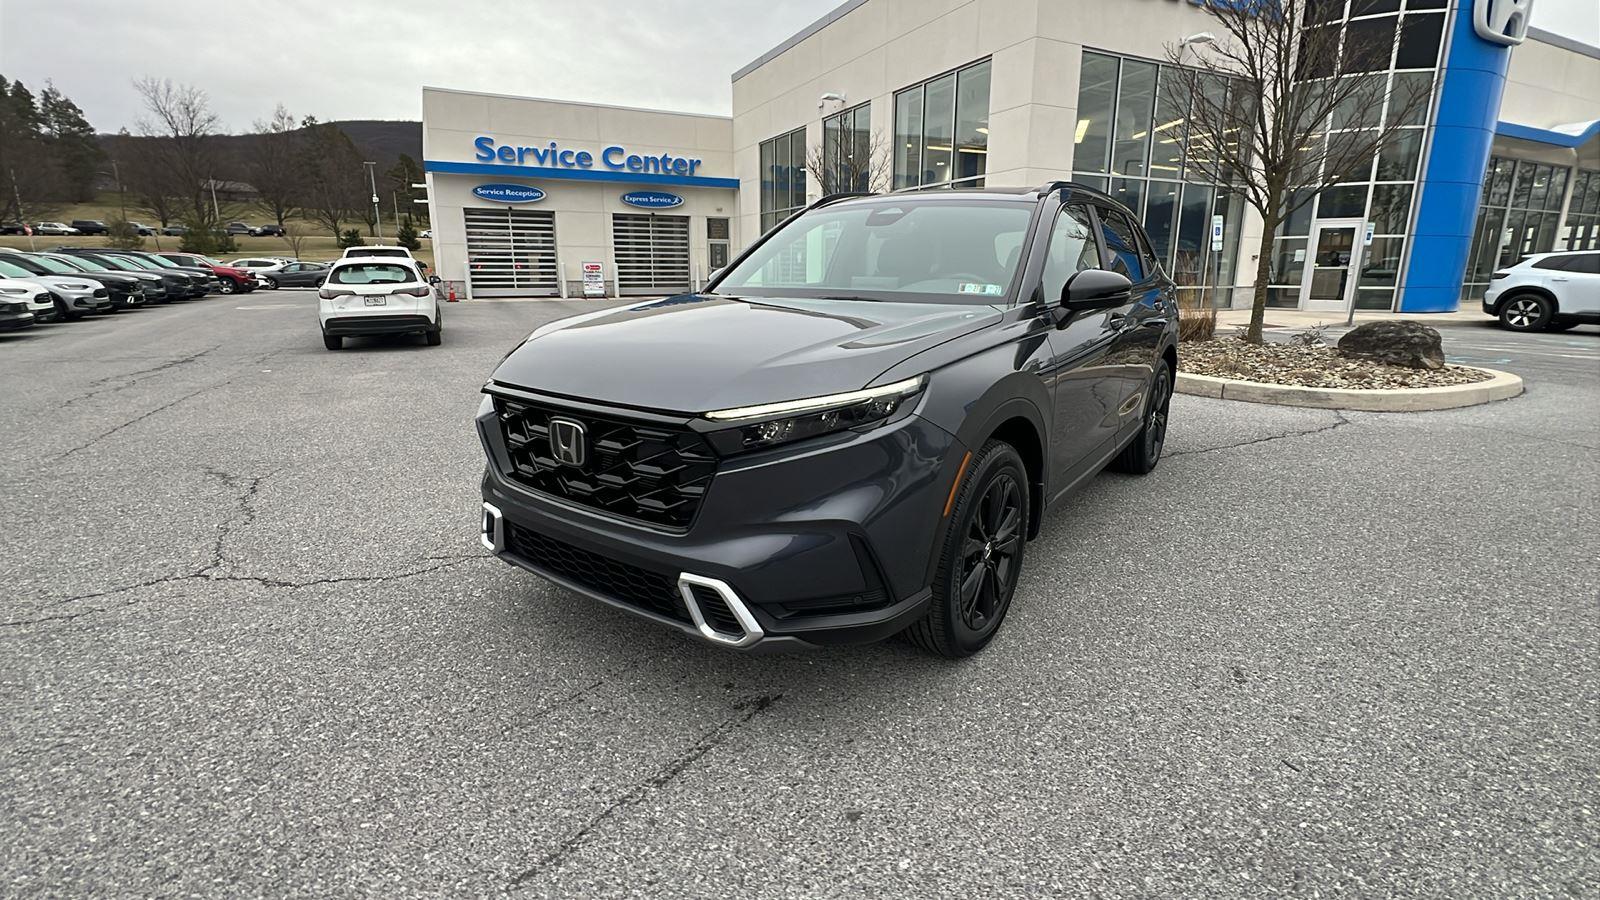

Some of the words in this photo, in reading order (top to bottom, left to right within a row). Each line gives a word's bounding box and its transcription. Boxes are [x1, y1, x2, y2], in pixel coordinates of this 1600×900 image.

[474, 136, 593, 169] Service
[602, 146, 702, 176] Center
[476, 187, 505, 197] Service
[506, 189, 542, 198] Reception
[624, 195, 648, 204] Express
[649, 196, 672, 204] Service
